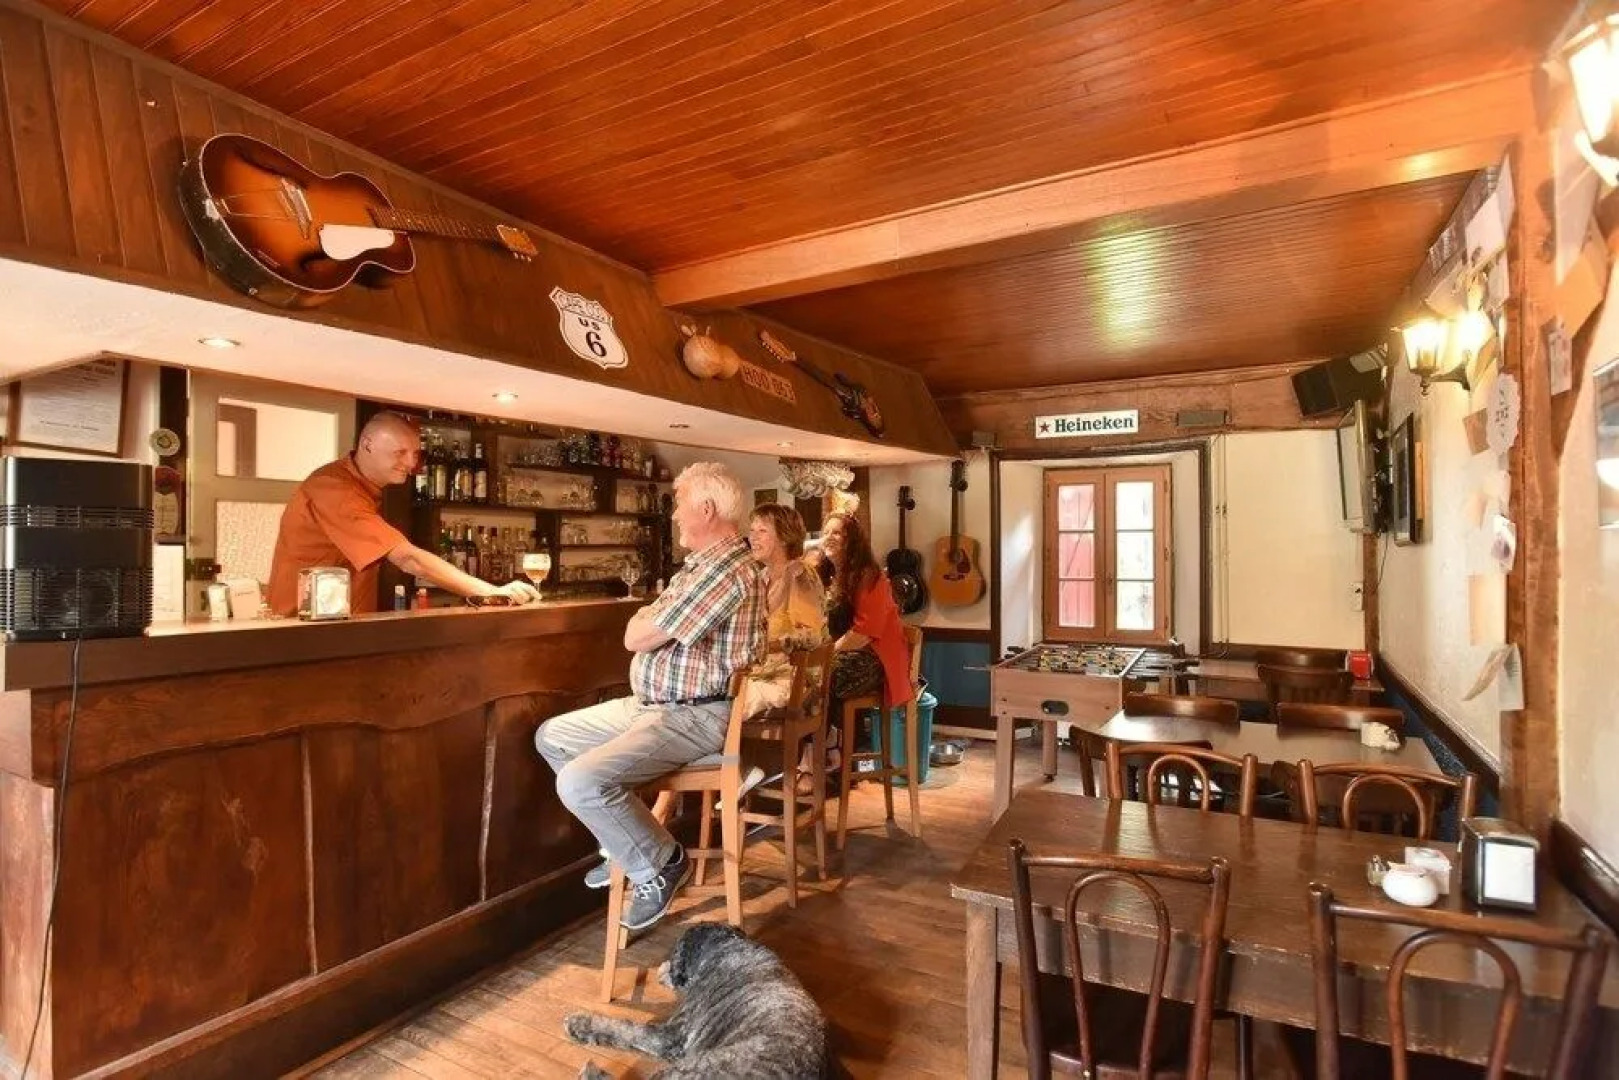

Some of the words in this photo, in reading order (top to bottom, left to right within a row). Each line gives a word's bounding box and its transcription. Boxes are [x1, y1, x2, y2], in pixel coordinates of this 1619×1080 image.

[577, 316, 601, 331] US
[585, 331, 607, 357] 6
[1054, 415, 1134, 433] Heineken
